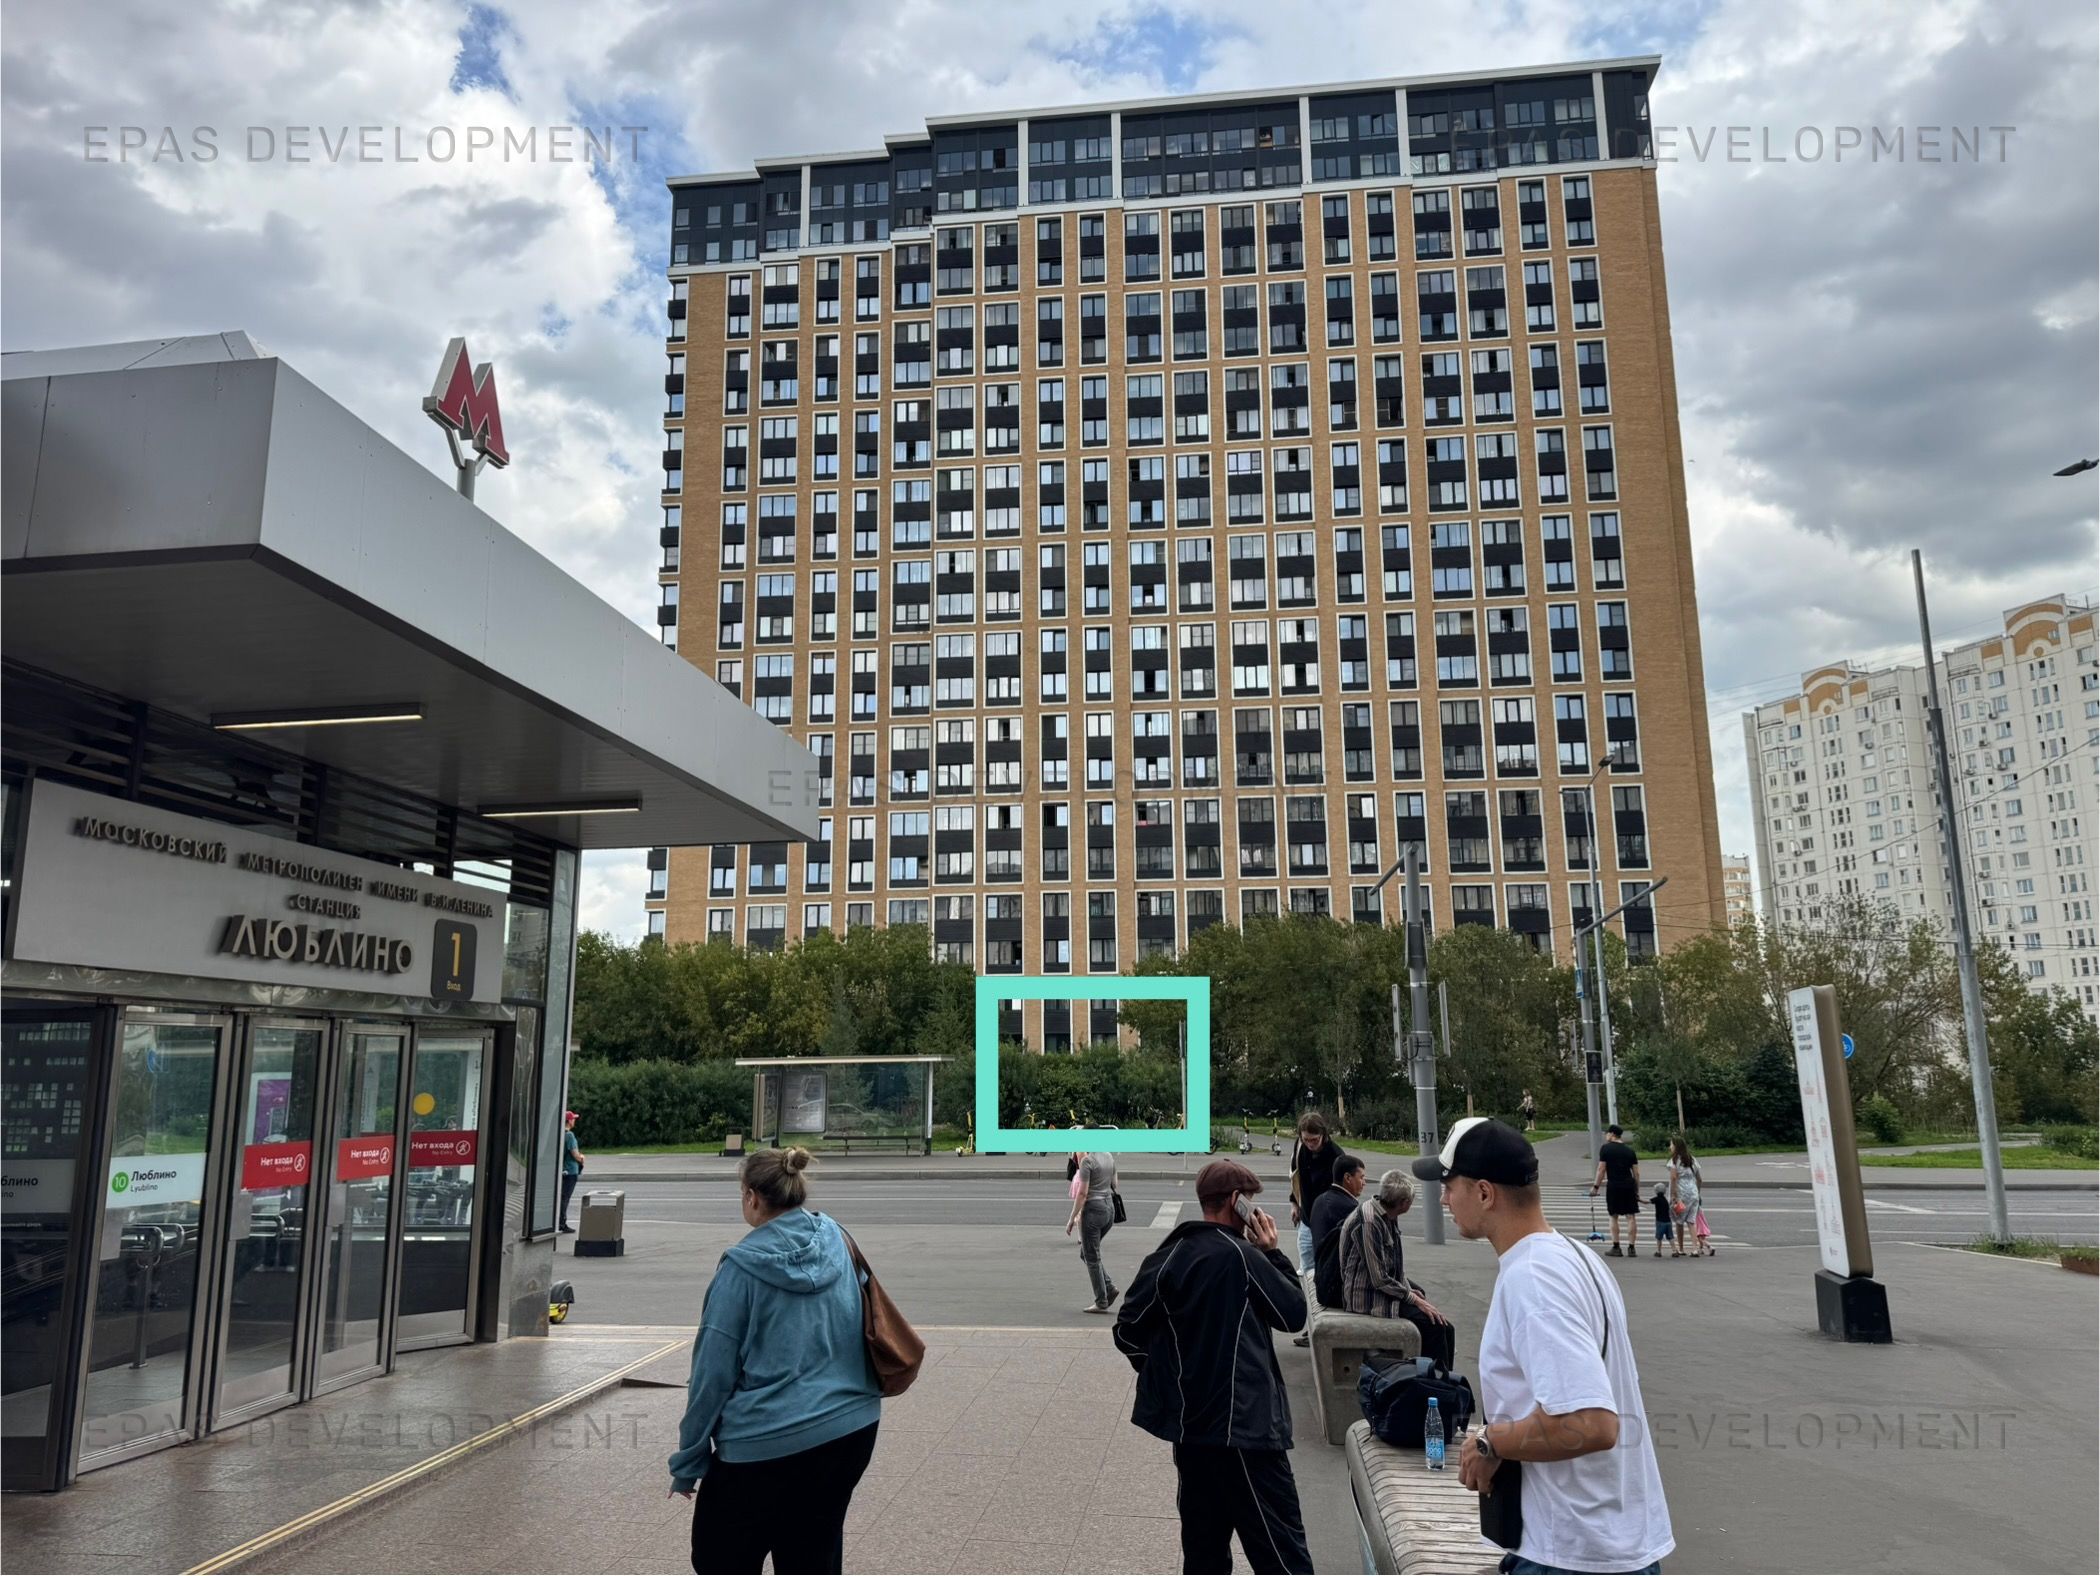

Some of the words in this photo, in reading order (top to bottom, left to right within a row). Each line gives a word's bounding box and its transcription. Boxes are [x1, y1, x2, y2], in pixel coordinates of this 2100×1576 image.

[83, 816, 227, 863] МОСКОВСКИЙ
[247, 853, 363, 892] МЕТРОПОЛИТЕН
[377, 881, 418, 902] ИМЕНИ
[297, 894, 361, 919] СТАНЦИЯ
[232, 915, 415, 974] ЛЮБЛИНО
[451, 933, 461, 976] 1
[411, 1142, 427, 1150] Нет
[429, 1142, 454, 1150] входа
[351, 1150, 362, 1158] Нет
[362, 1150, 379, 1158] входа
[260, 1157, 273, 1166] Нет
[274, 1156, 293, 1166] входа
[131, 1169, 177, 1182] Люблино
[114, 1176, 127, 1189] 10
[130, 1183, 159, 1193] Lyublino
